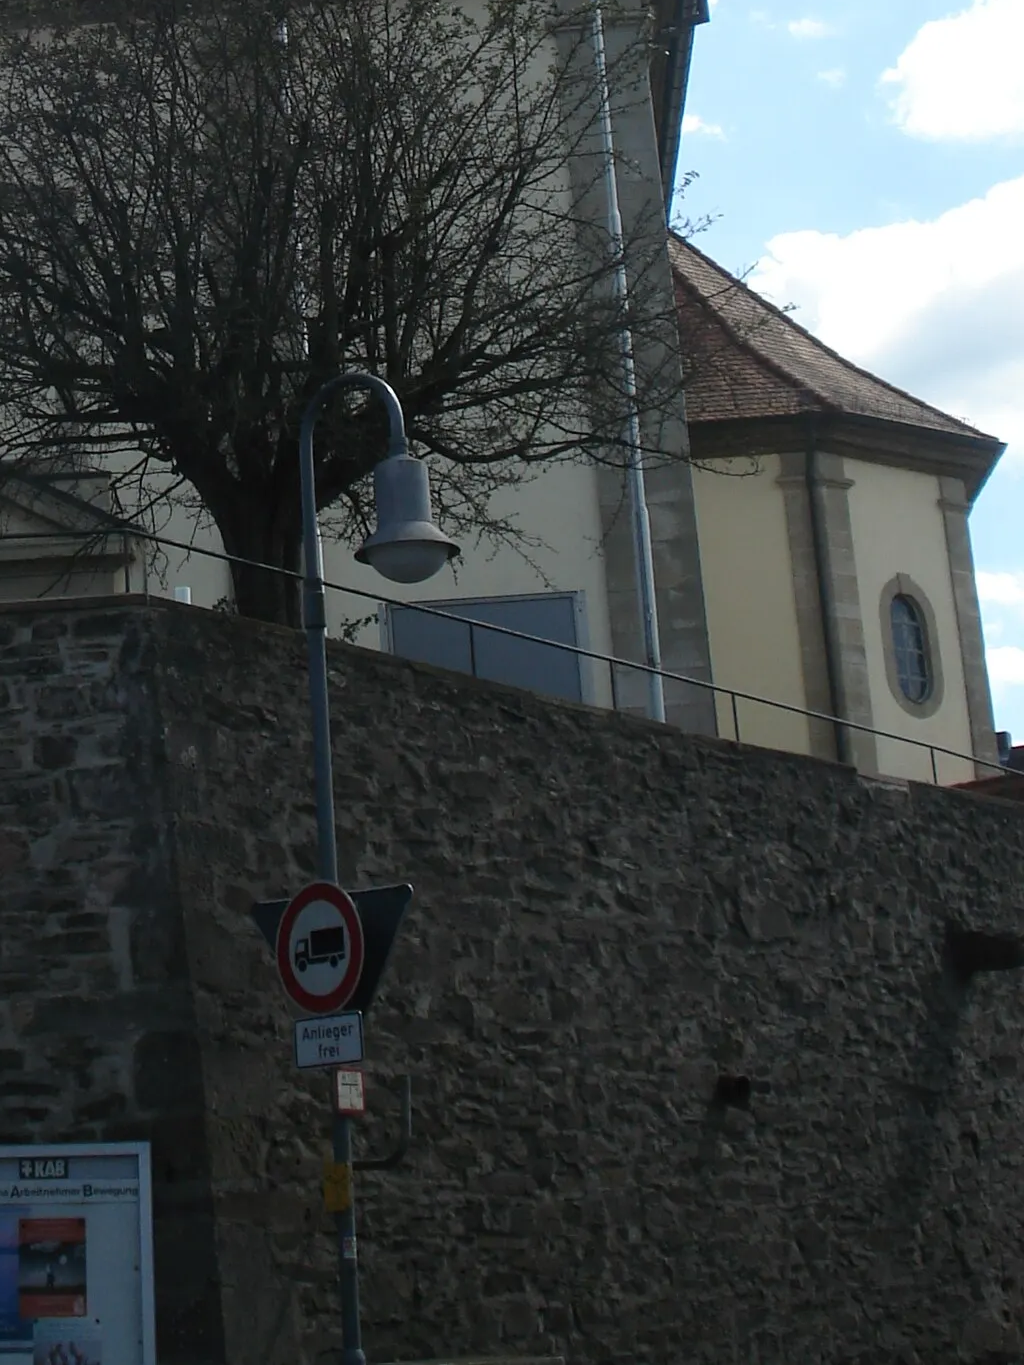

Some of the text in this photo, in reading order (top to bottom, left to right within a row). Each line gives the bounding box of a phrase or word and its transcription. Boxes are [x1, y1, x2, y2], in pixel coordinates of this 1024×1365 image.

[302, 1024, 354, 1042] Anlieger
[318, 1043, 340, 1058] frei
[34, 1160, 65, 1178] KAB
[10, 1185, 81, 1199] Arbeitnehmer
[83, 1184, 138, 1198] Bewegung
